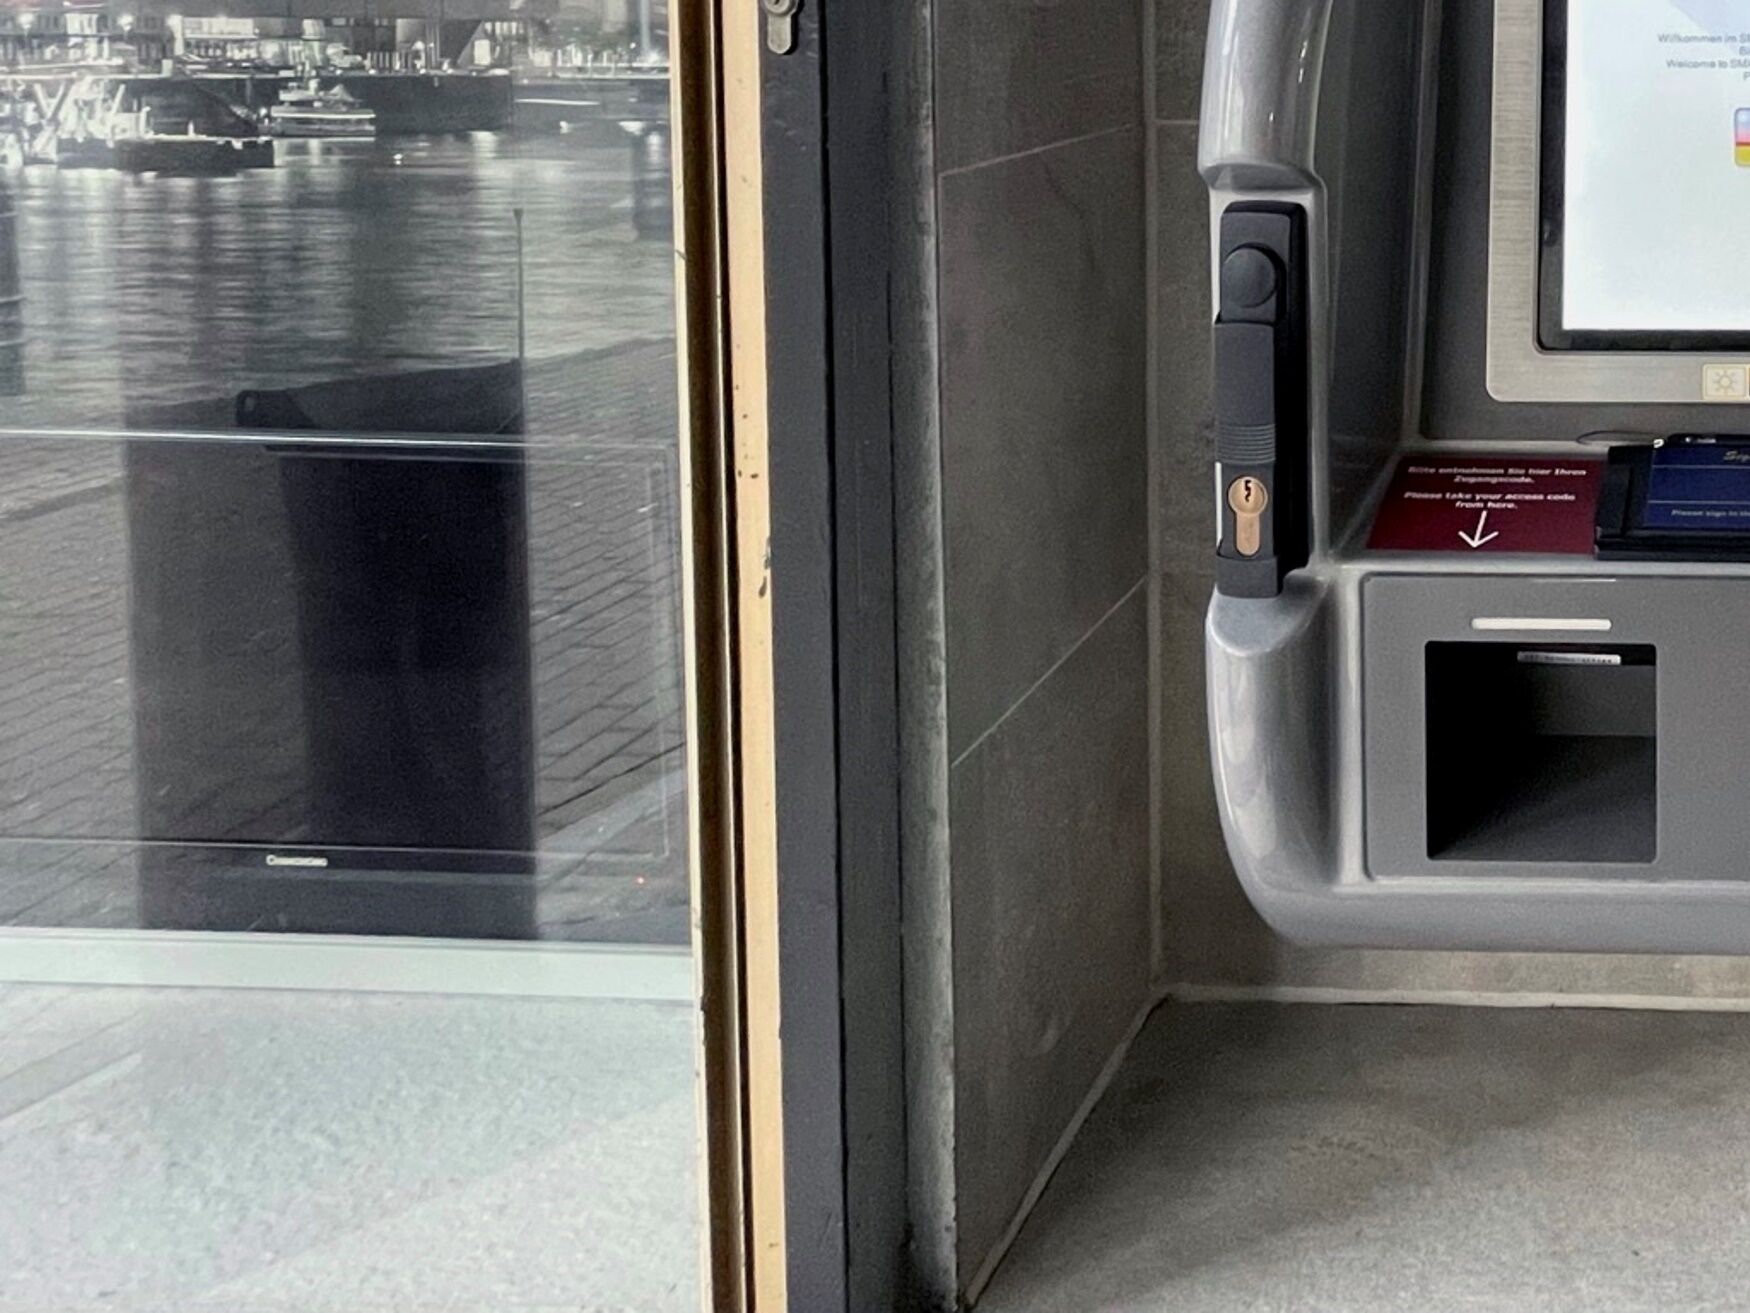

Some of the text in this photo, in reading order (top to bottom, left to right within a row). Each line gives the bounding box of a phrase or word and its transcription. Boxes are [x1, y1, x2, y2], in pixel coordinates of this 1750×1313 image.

[1657, 33, 1723, 43] Willkommen
[1724, 33, 1737, 43] im
[1666, 59, 1716, 68] Welcome
[1718, 59, 1728, 68] to
[1408, 466, 1436, 474] Bitte
[1438, 467, 1504, 475] entnehmen
[1554, 468, 1587, 476] Ihren
[1454, 475, 1535, 484] Zugangscode.
[1446, 492, 1472, 500] take
[1475, 493, 1501, 501] your
[1547, 493, 1576, 501] code
[1487, 501, 1518, 509] here.
[1706, 510, 1726, 518] sign
